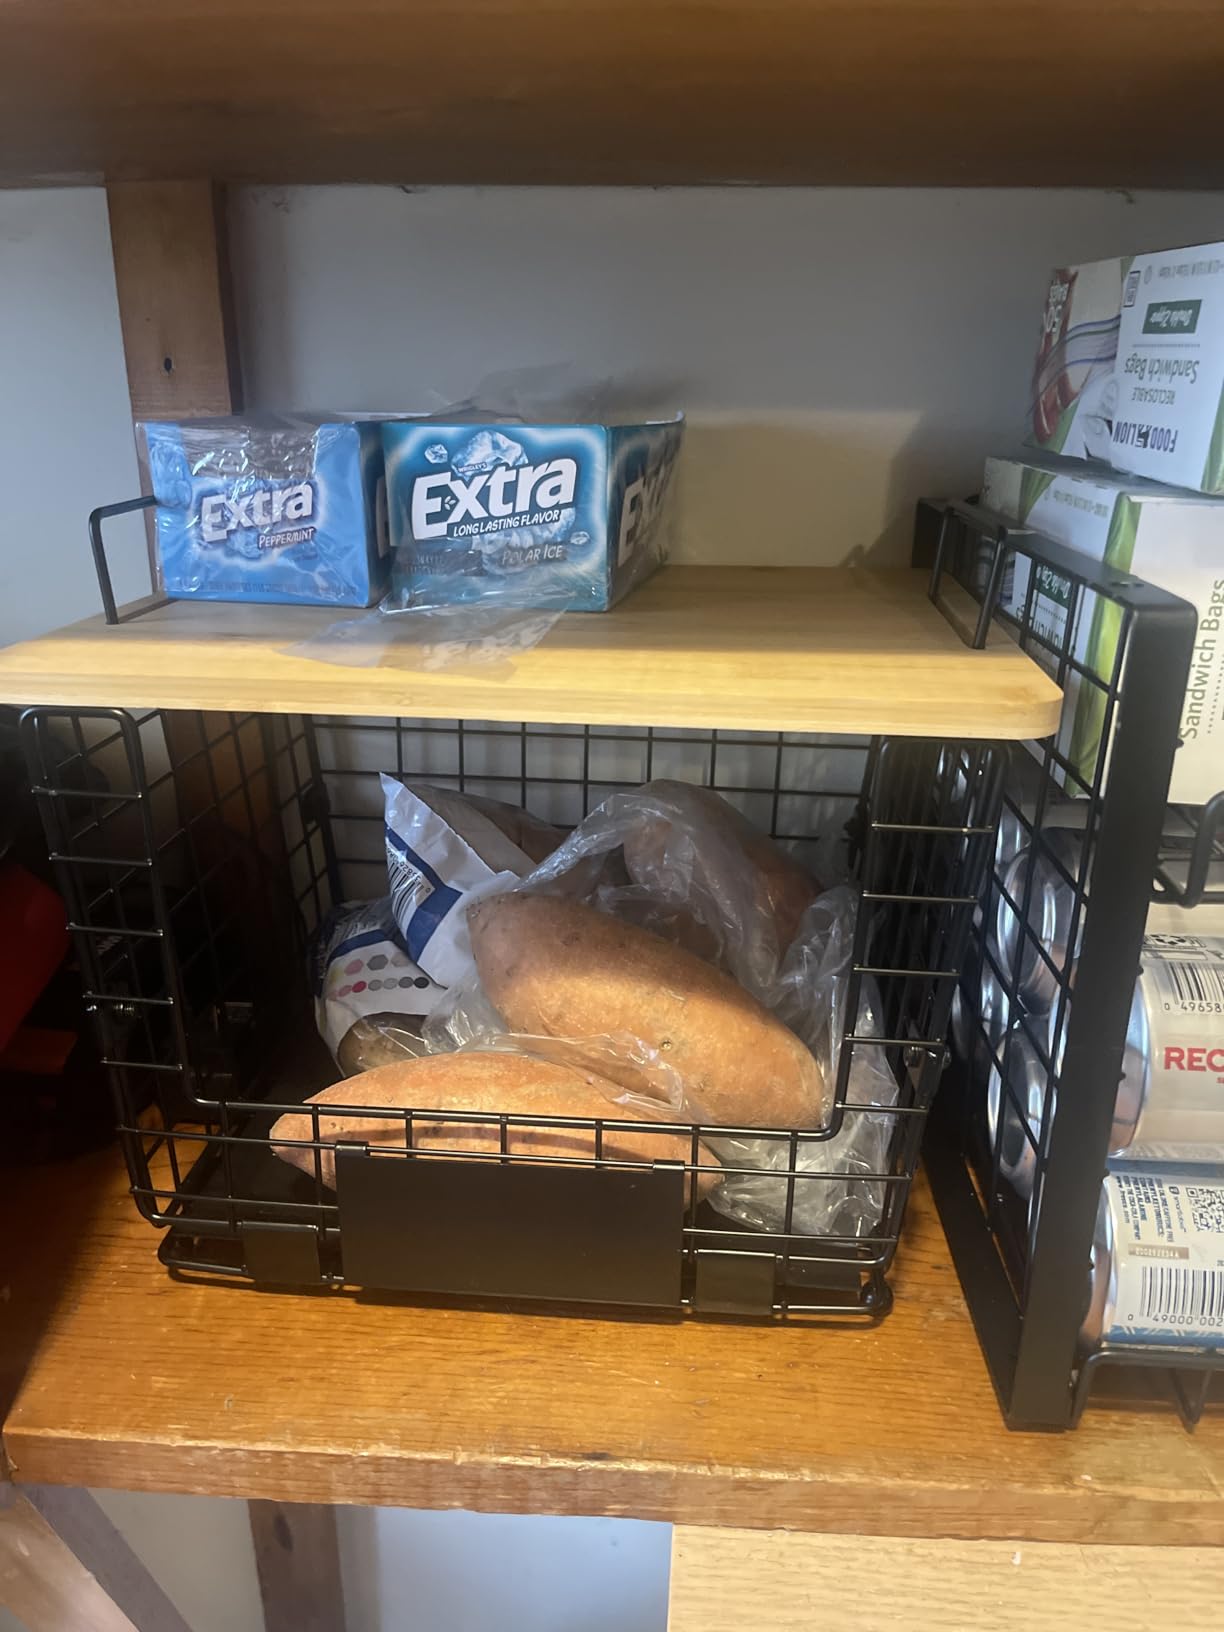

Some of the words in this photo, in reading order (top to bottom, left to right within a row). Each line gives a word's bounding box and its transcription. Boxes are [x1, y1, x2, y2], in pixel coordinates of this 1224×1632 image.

[1124, 352, 1148, 381] Bags
[1148, 358, 1200, 384] Sandwich
[1131, 387, 1176, 405] RECLOSABLE
[1113, 421, 1137, 446] LION
[1150, 426, 1178, 453] FOOD
[411, 458, 577, 541] Extra
[201, 484, 313, 543] Extra
[453, 520, 479, 537] LONG
[480, 514, 520, 534] LASTING
[520, 509, 560, 530] FLAVOR
[258, 528, 315, 548] PEPPERMINT
[502, 546, 541, 565] POLAR
[543, 544, 564, 560] ICE
[1179, 638, 1216, 740] Sandwich
[1199, 579, 1224, 632] Bags
[1164, 1002, 1171, 1012] 0
[1180, 1001, 1222, 1014] 49658
[1128, 1314, 1134, 1322] 0
[1152, 1314, 1194, 1326] 49000
